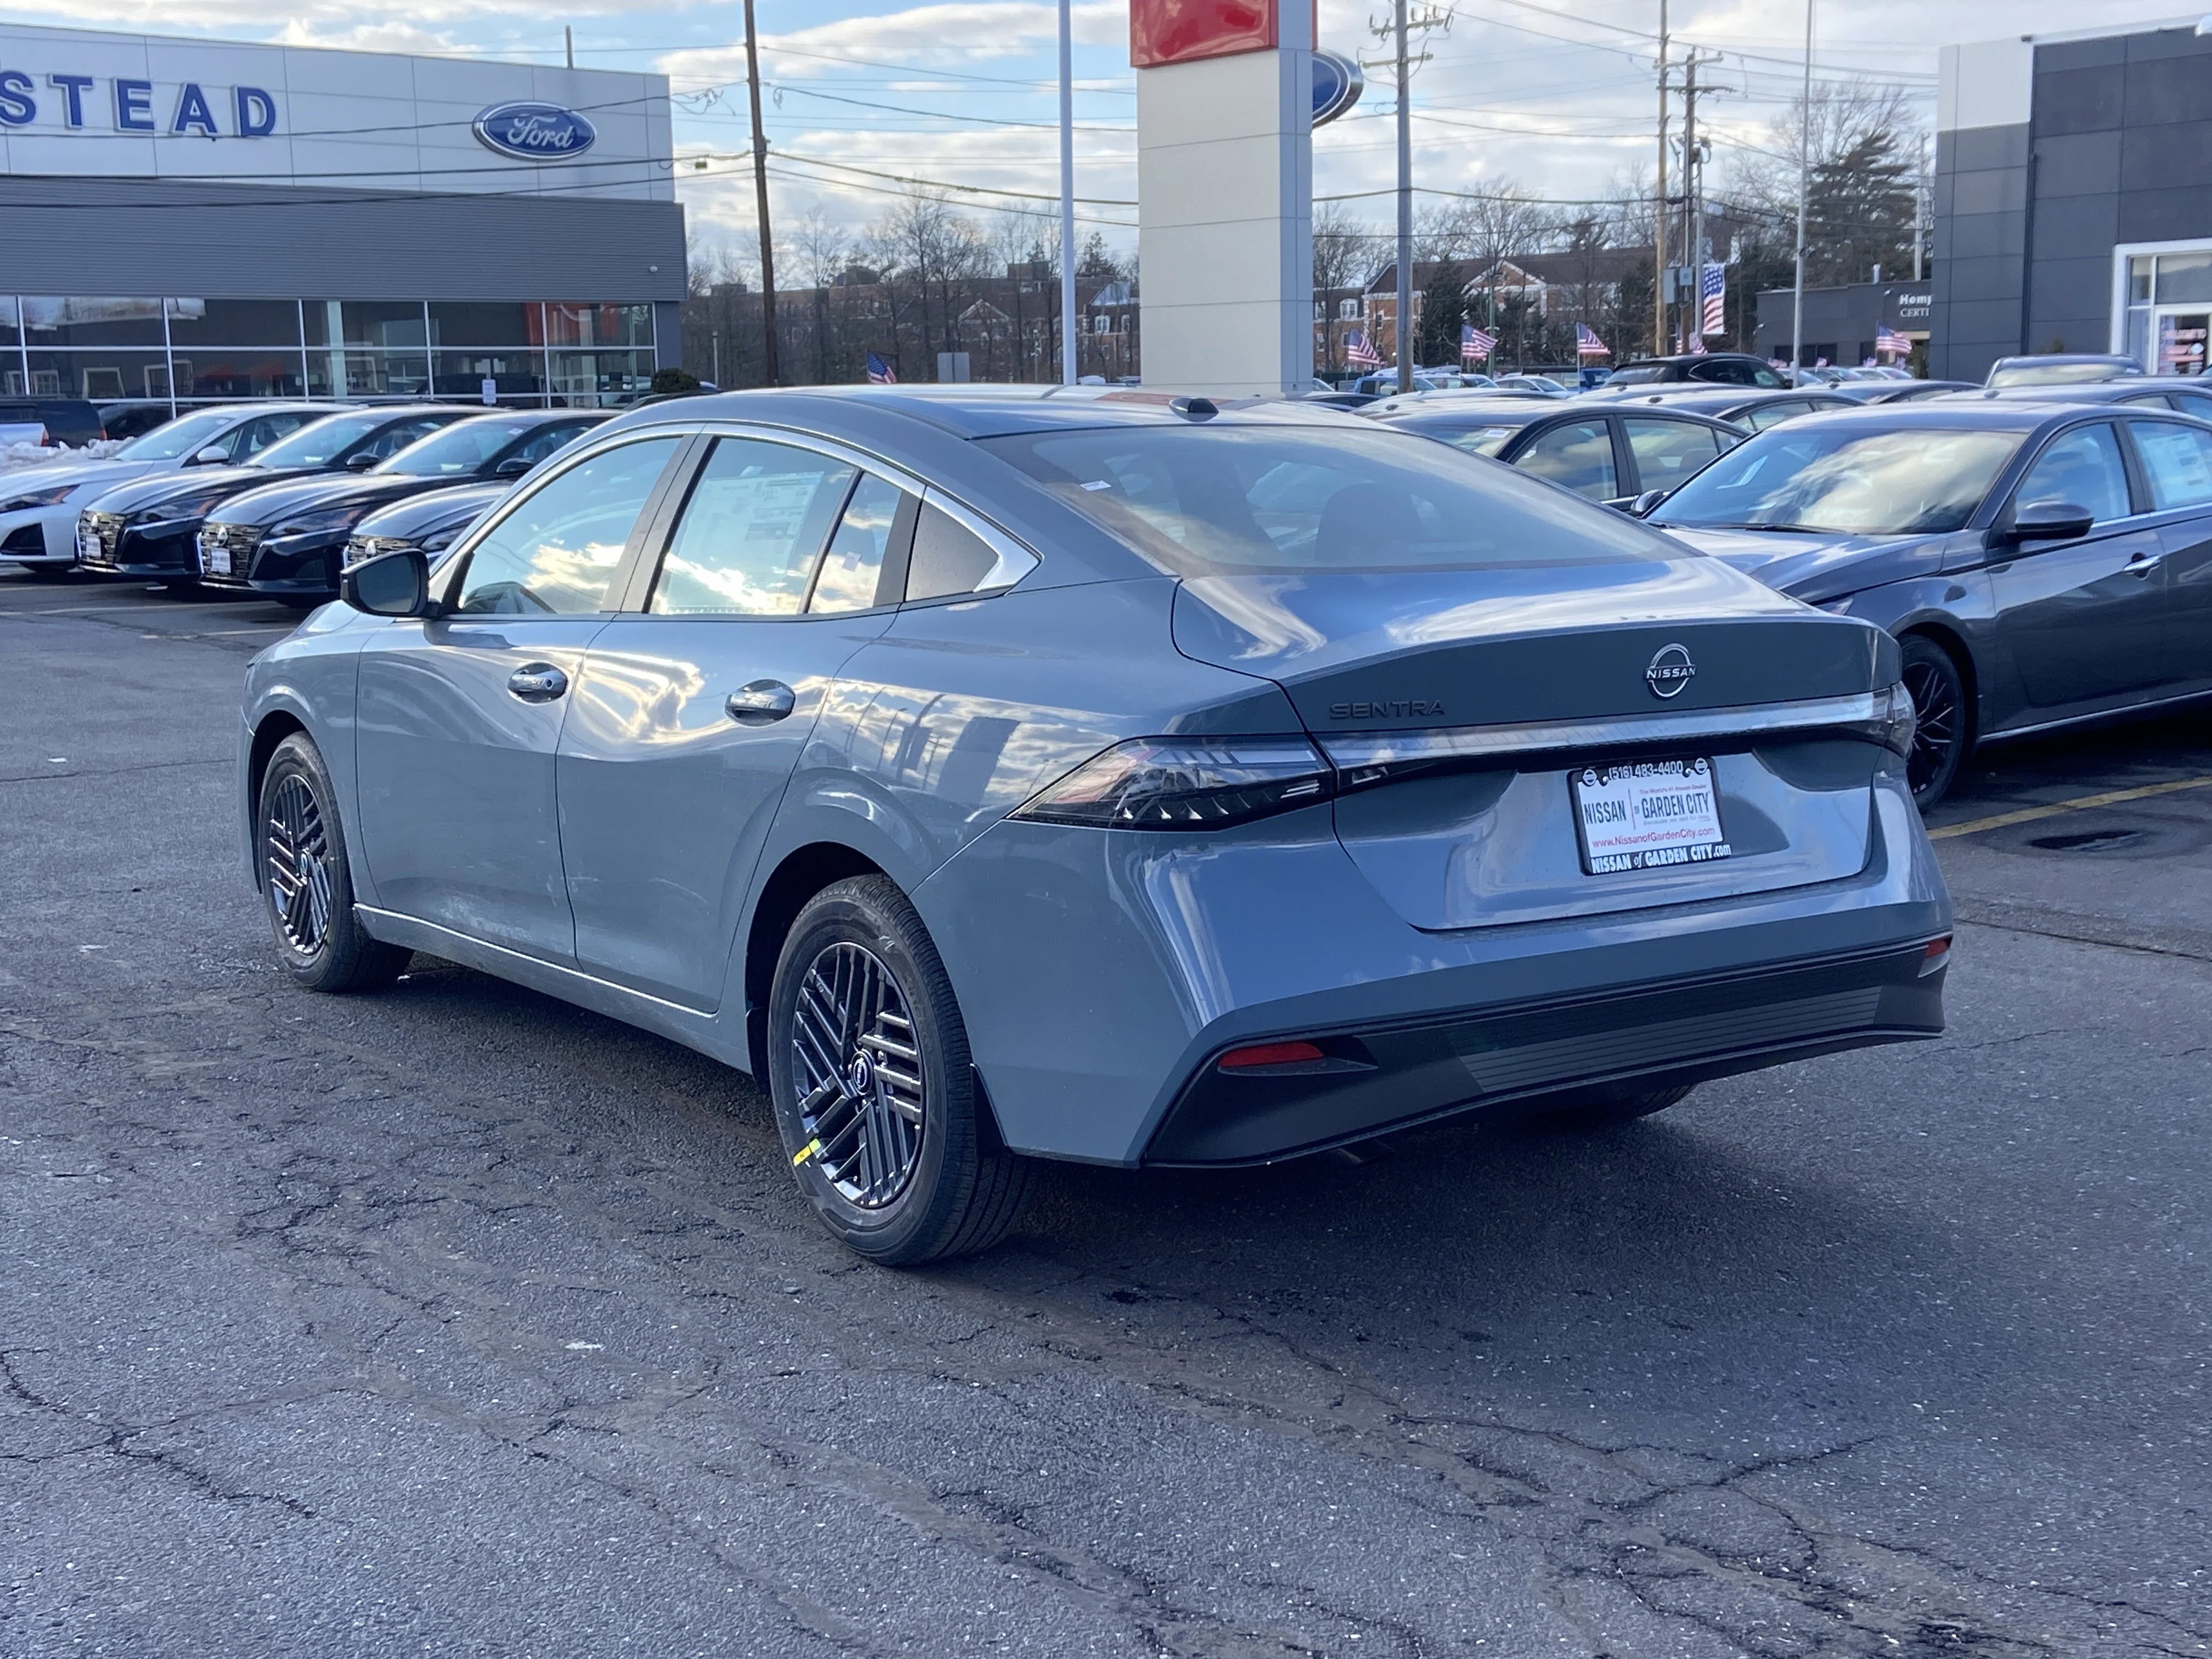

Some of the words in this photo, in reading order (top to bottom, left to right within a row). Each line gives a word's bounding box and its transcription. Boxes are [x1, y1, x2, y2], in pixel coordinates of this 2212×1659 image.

[0, 70, 276, 138] STEAD
[507, 114, 574, 148] Ford
[1646, 667, 1696, 679] NISSAN
[1330, 699, 1445, 720] SENTRA
[1608, 765, 1633, 780] (516)
[1634, 760, 1684, 778] 483-4400
[1584, 800, 1627, 825] NISSAN
[1641, 794, 1685, 819] GARDEN
[1686, 792, 1709, 814] CITY
[1592, 827, 1716, 848] www.NissanofGardenCity.com
[1592, 854, 1632, 874] NISSAN
[1633, 851, 1643, 868] of
[1645, 847, 1689, 866] GARDEN
